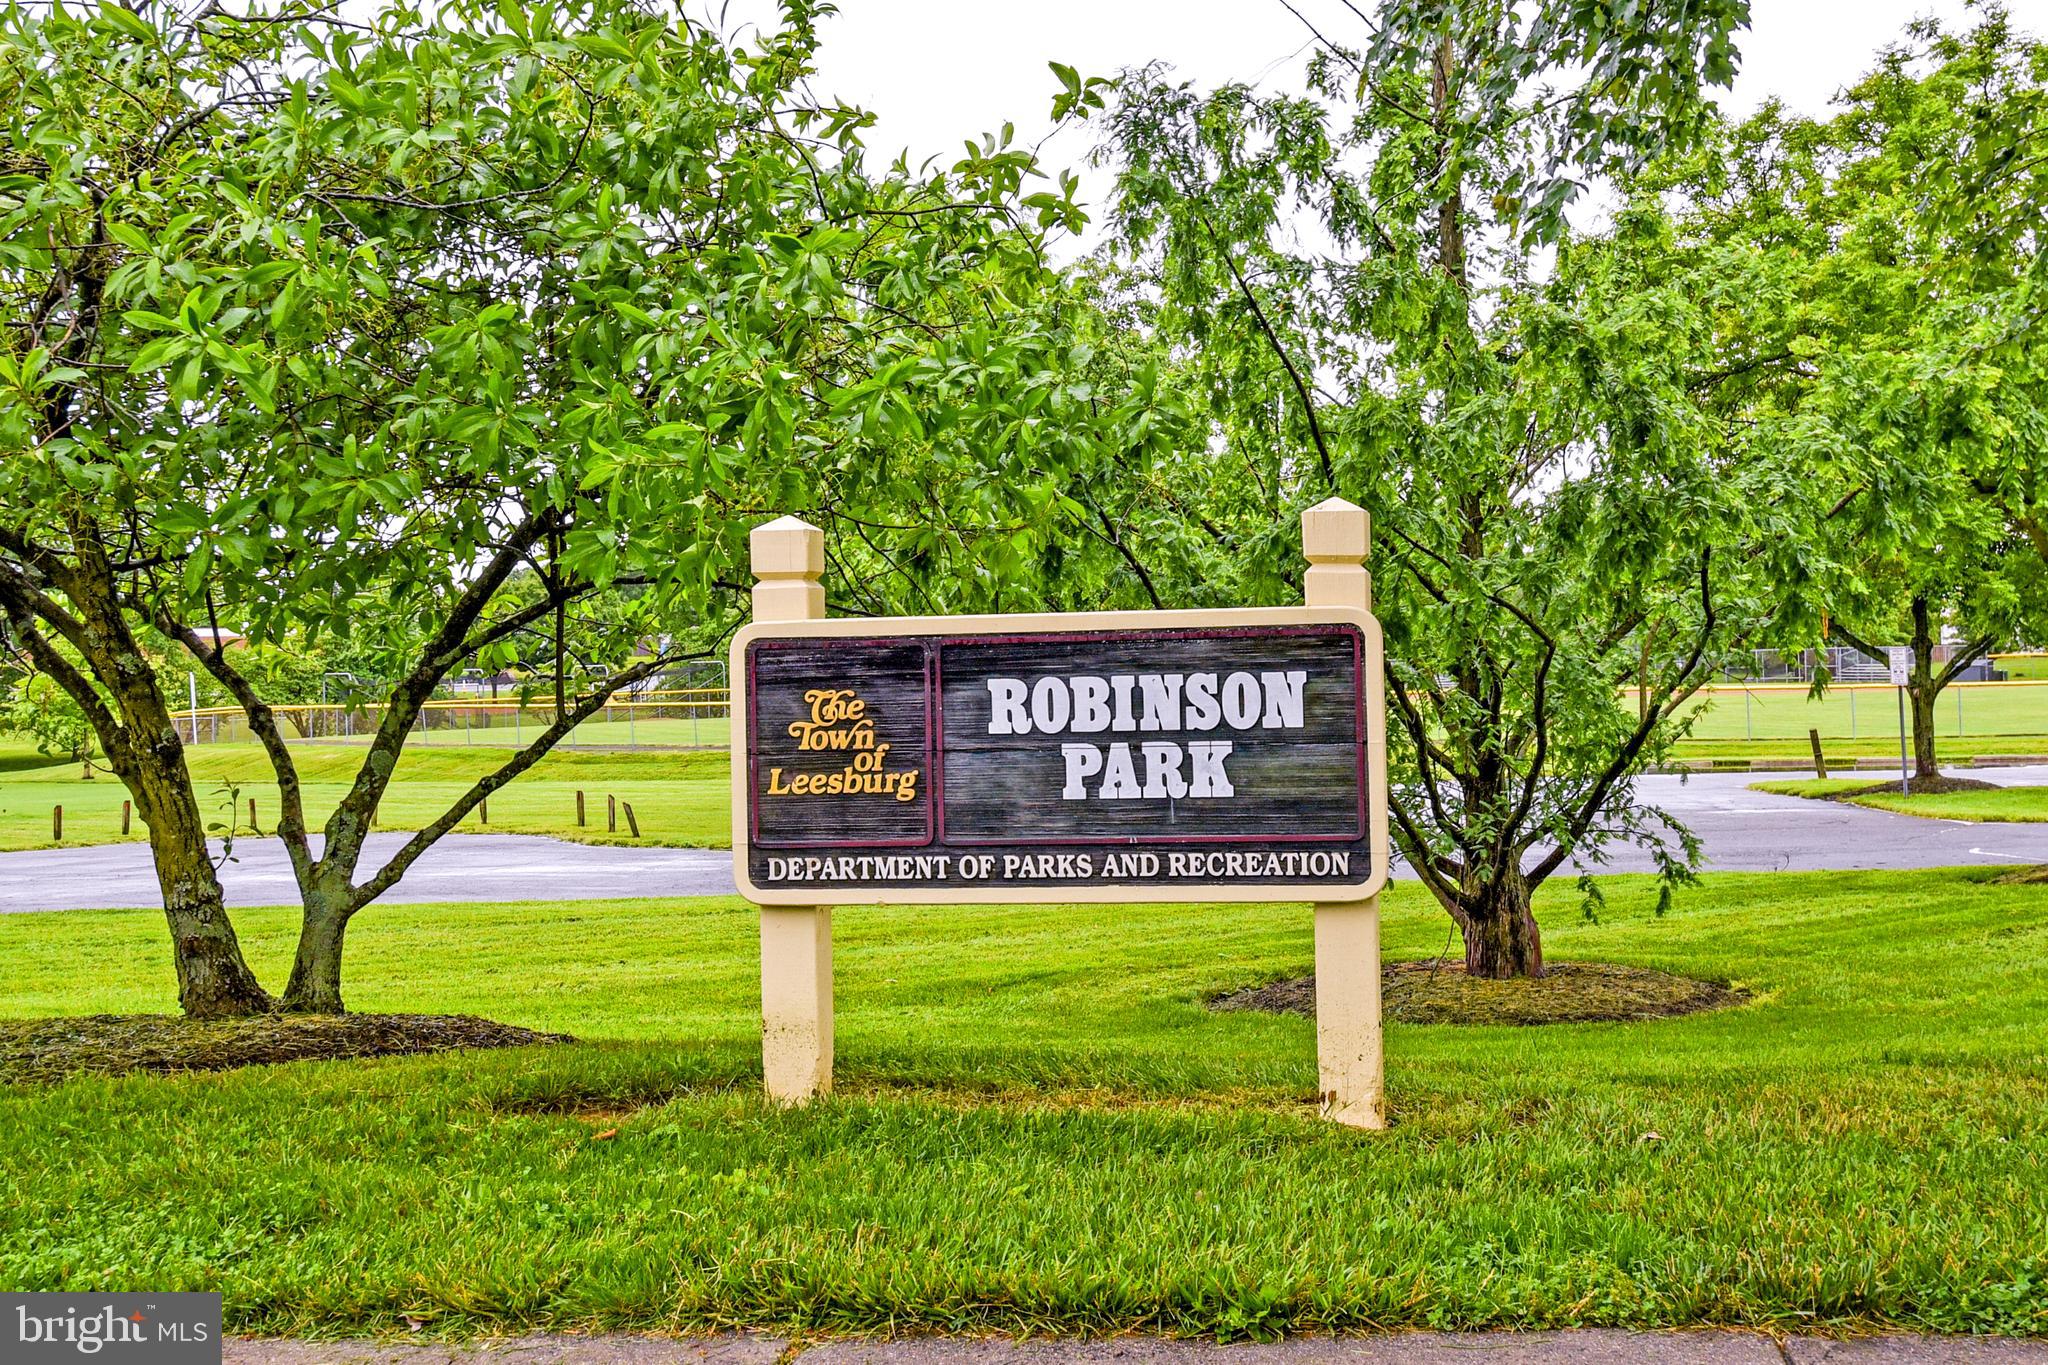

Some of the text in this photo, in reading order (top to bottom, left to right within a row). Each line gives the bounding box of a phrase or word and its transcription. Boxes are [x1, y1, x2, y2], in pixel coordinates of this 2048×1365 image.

[803, 689, 866, 727] The
[987, 670, 1308, 736] ROBINSON
[787, 719, 875, 752] Town
[853, 743, 890, 774] of
[1060, 740, 1236, 801] PARK
[768, 768, 919, 802] Leesburg
[767, 850, 1350, 882] DEPARTMENT OF PARKS AND RECREATION
